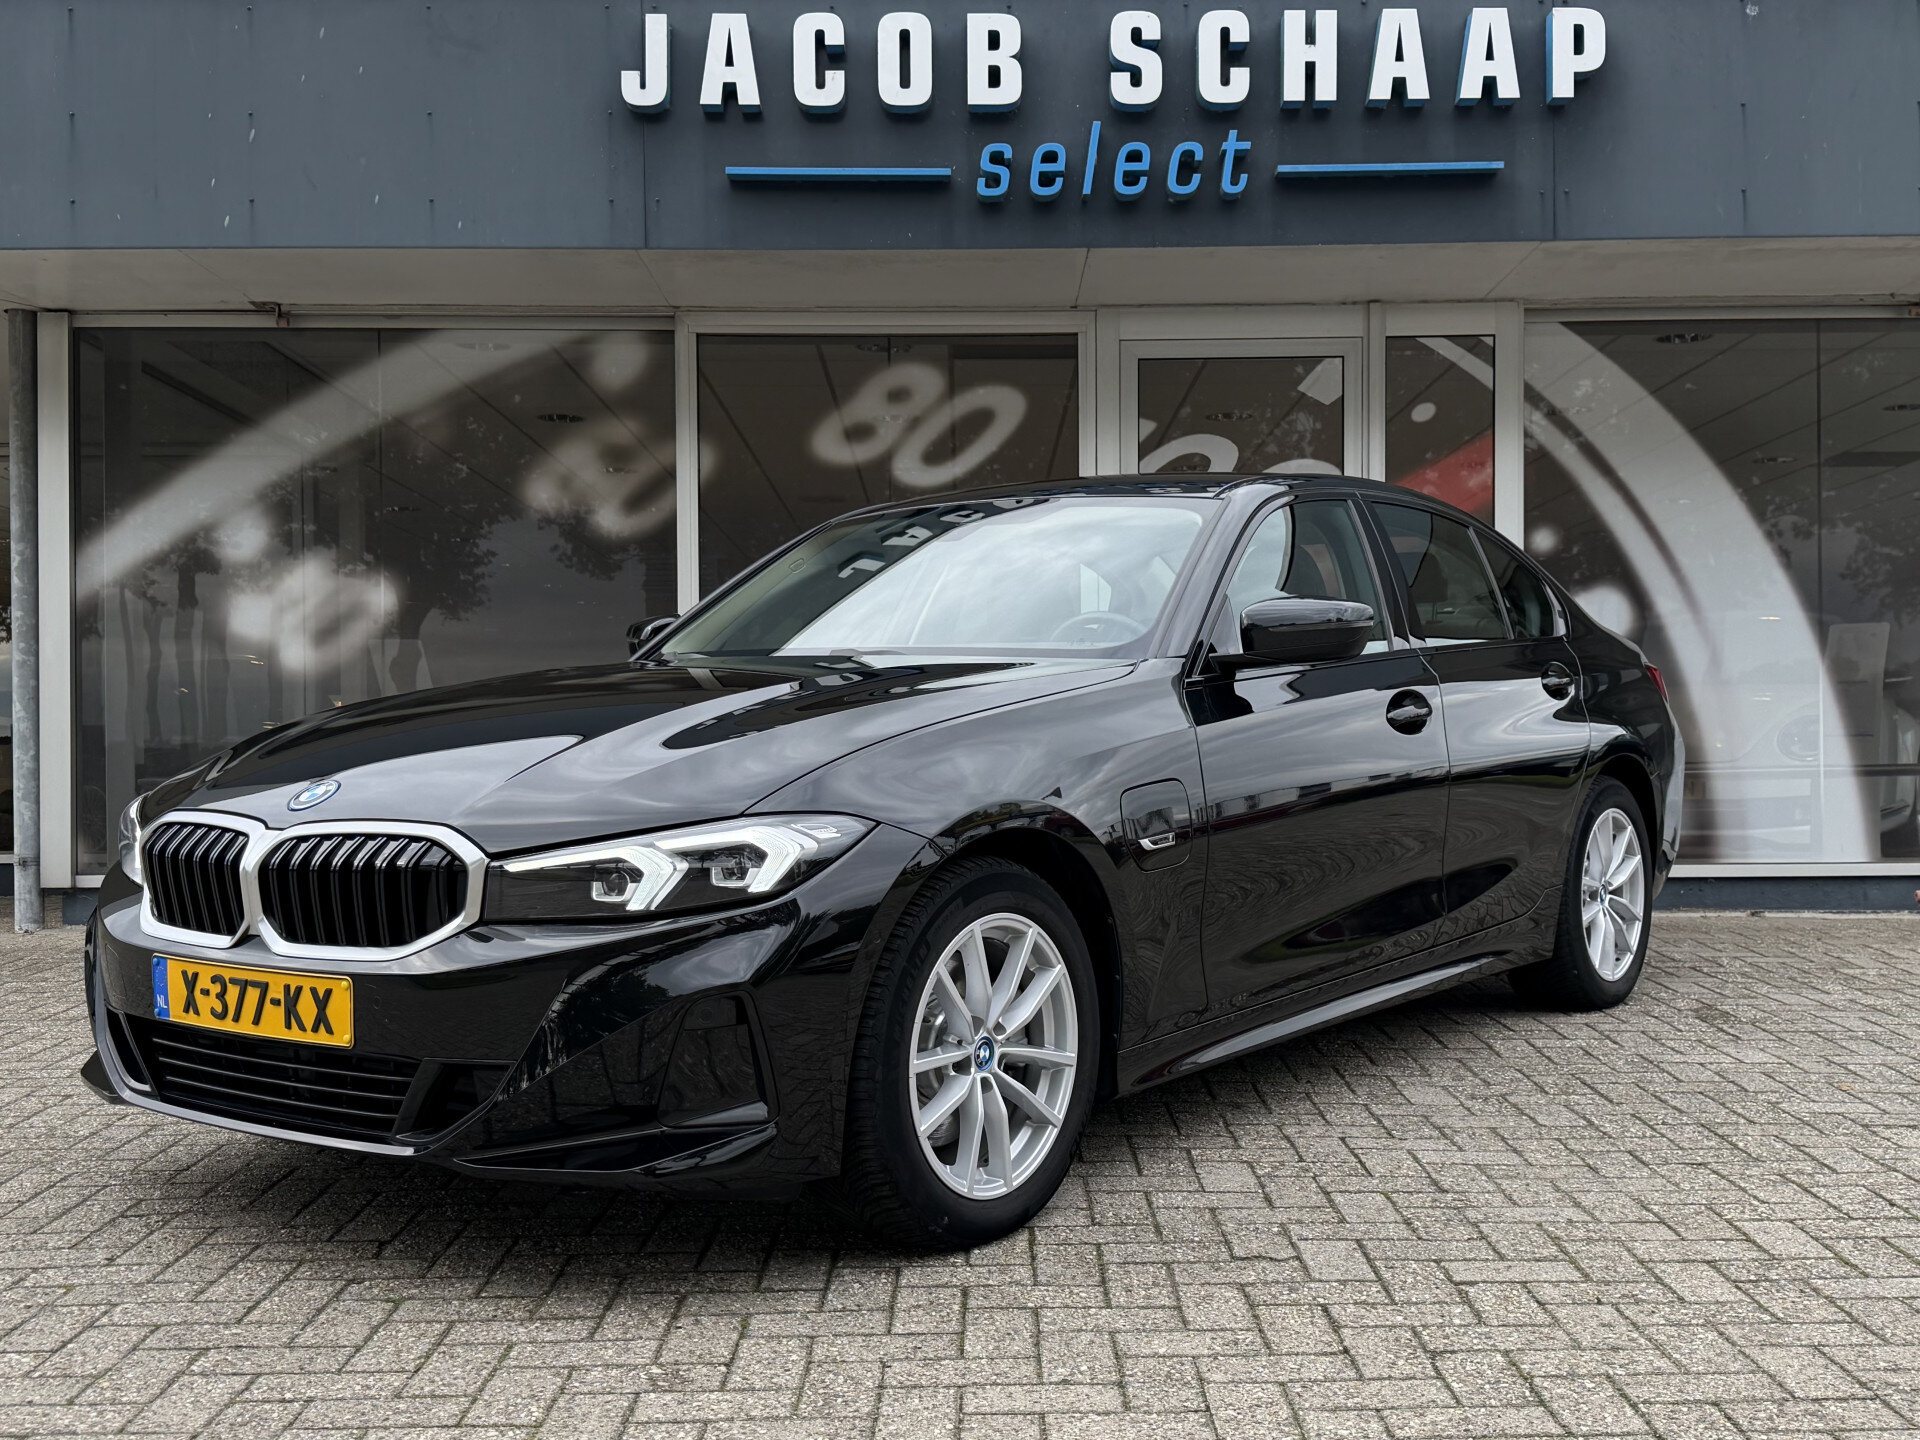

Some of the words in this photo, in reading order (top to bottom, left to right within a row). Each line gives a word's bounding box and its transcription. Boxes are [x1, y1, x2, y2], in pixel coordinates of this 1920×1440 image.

[620, 11, 1023, 110] JACOB
[1109, 7, 1606, 108] SCHAAP
[976, 120, 1252, 198] select
[810, 363, 1028, 488] 80
[156, 993, 168, 1009] NL
[180, 969, 335, 1036] X-377-KX
